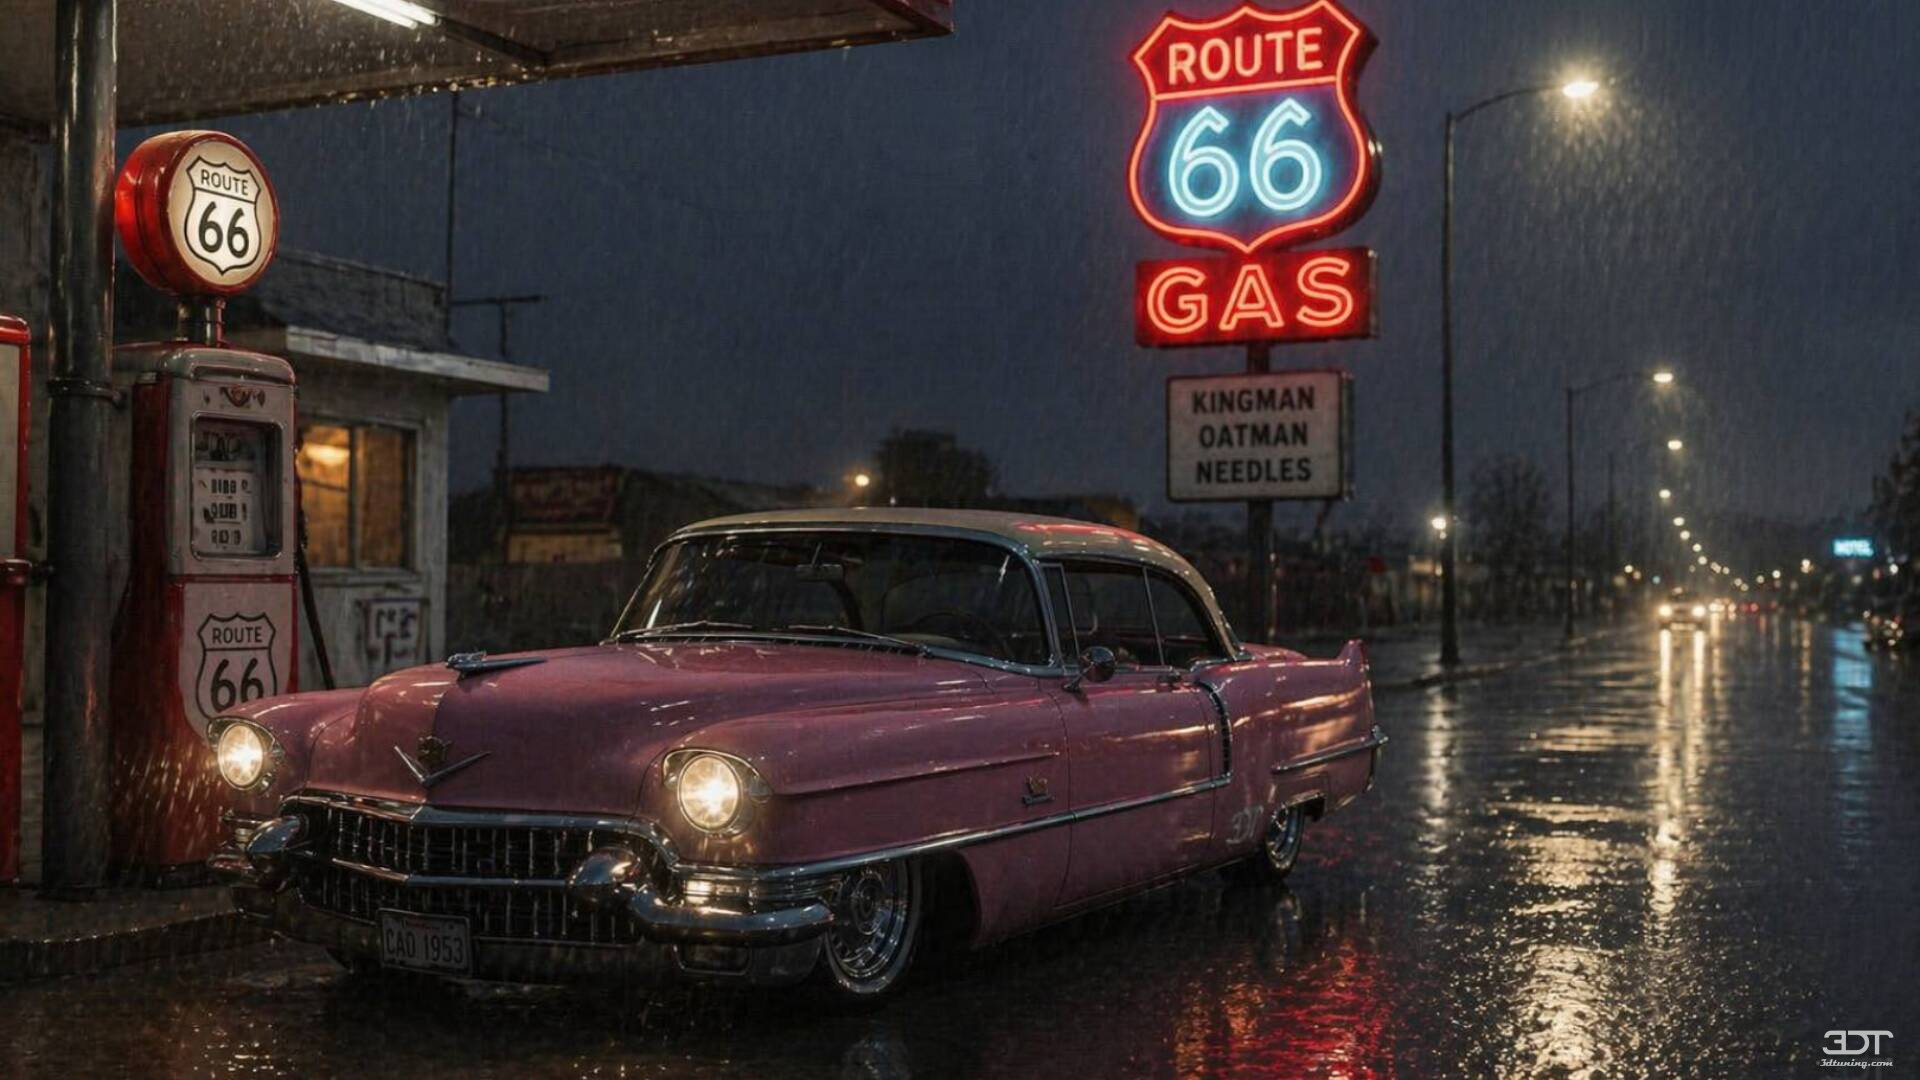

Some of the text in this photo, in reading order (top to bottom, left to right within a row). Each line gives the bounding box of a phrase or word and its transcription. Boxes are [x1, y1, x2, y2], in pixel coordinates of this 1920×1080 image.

[1168, 27, 1323, 85] ROUTE
[1168, 97, 1322, 217] 66
[201, 169, 248, 196] ROUTE
[198, 201, 249, 259] 66
[1147, 256, 1353, 335] GAS
[1192, 386, 1315, 414] KINGMAN
[1199, 422, 1308, 448] OATMAN
[1195, 457, 1312, 484] NEEDLES
[212, 626, 262, 644] ROUTE
[211, 658, 264, 713] 66
[386, 928, 464, 964] CAD 1953
